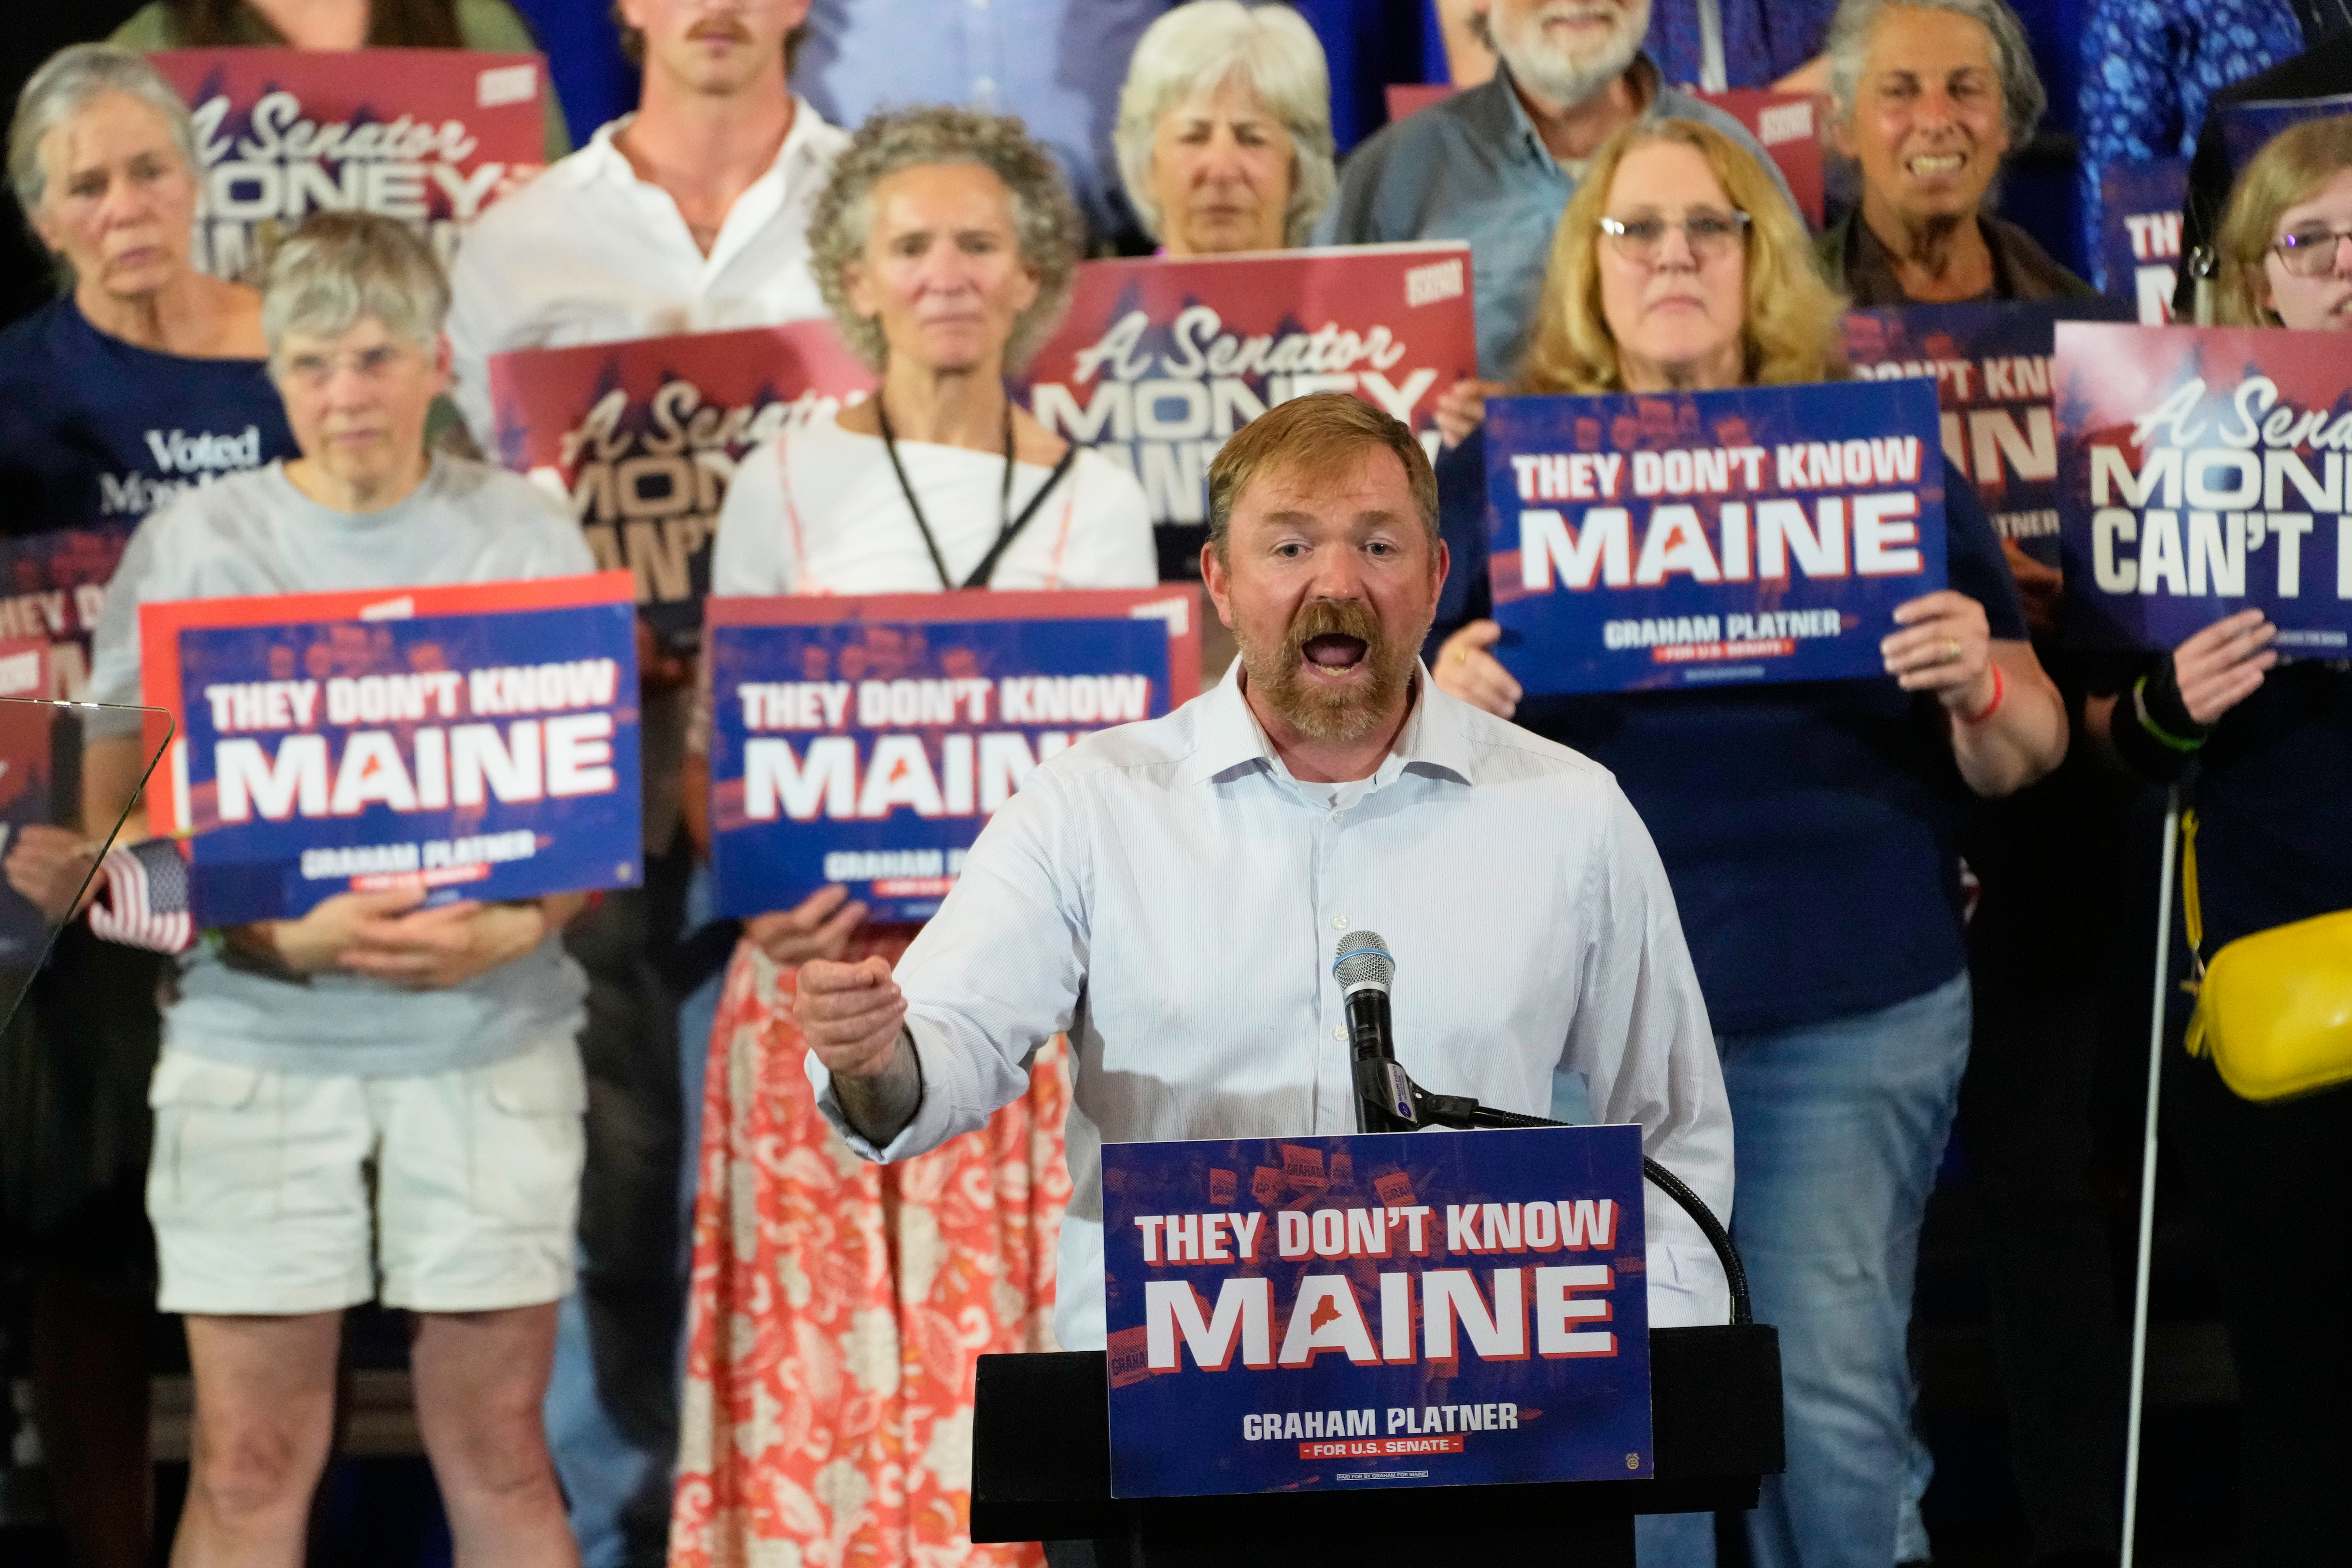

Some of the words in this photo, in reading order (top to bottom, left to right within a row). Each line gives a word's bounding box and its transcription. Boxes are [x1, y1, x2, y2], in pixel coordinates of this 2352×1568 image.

[239, 92, 479, 163] Senator
[195, 161, 505, 218] ONEY
[1073, 310, 1154, 383] A
[1163, 306, 1406, 379] Senator
[145, 426, 261, 472] Voted
[559, 389, 629, 461] A
[2131, 376, 2207, 448] A
[2219, 375, 2352, 452] Sena
[1512, 452, 1621, 500] THEY
[1633, 446, 1765, 495] DON'T
[1776, 437, 1919, 490] KNOW
[2091, 447, 2352, 513] MON
[1519, 492, 1922, 590] MAINE
[2092, 508, 2314, 598] CAN'T
[1605, 614, 1720, 649] GRAHAM
[1727, 608, 1841, 641] PLATNER
[206, 680, 318, 732] THEY
[327, 671, 462, 724] DON'T
[470, 658, 616, 714] KNOW
[738, 682, 851, 730] THEY
[858, 677, 993, 727] DON'T
[1001, 675, 1147, 722] KNOW
[215, 713, 617, 821] MAINE
[745, 732, 1093, 818] MAIN
[1134, 1212, 1263, 1262] THEY
[1278, 1205, 1429, 1257] DON'T
[1447, 1199, 1612, 1252] KNOW
[1145, 1265, 1612, 1368] MAINE
[1243, 1409, 1376, 1441] GRAHAM
[1387, 1403, 1518, 1435] PLATNER
[1314, 1444, 1346, 1457] FOR
[1352, 1442, 1381, 1455] U.S.
[1386, 1440, 1449, 1453] SENATE
